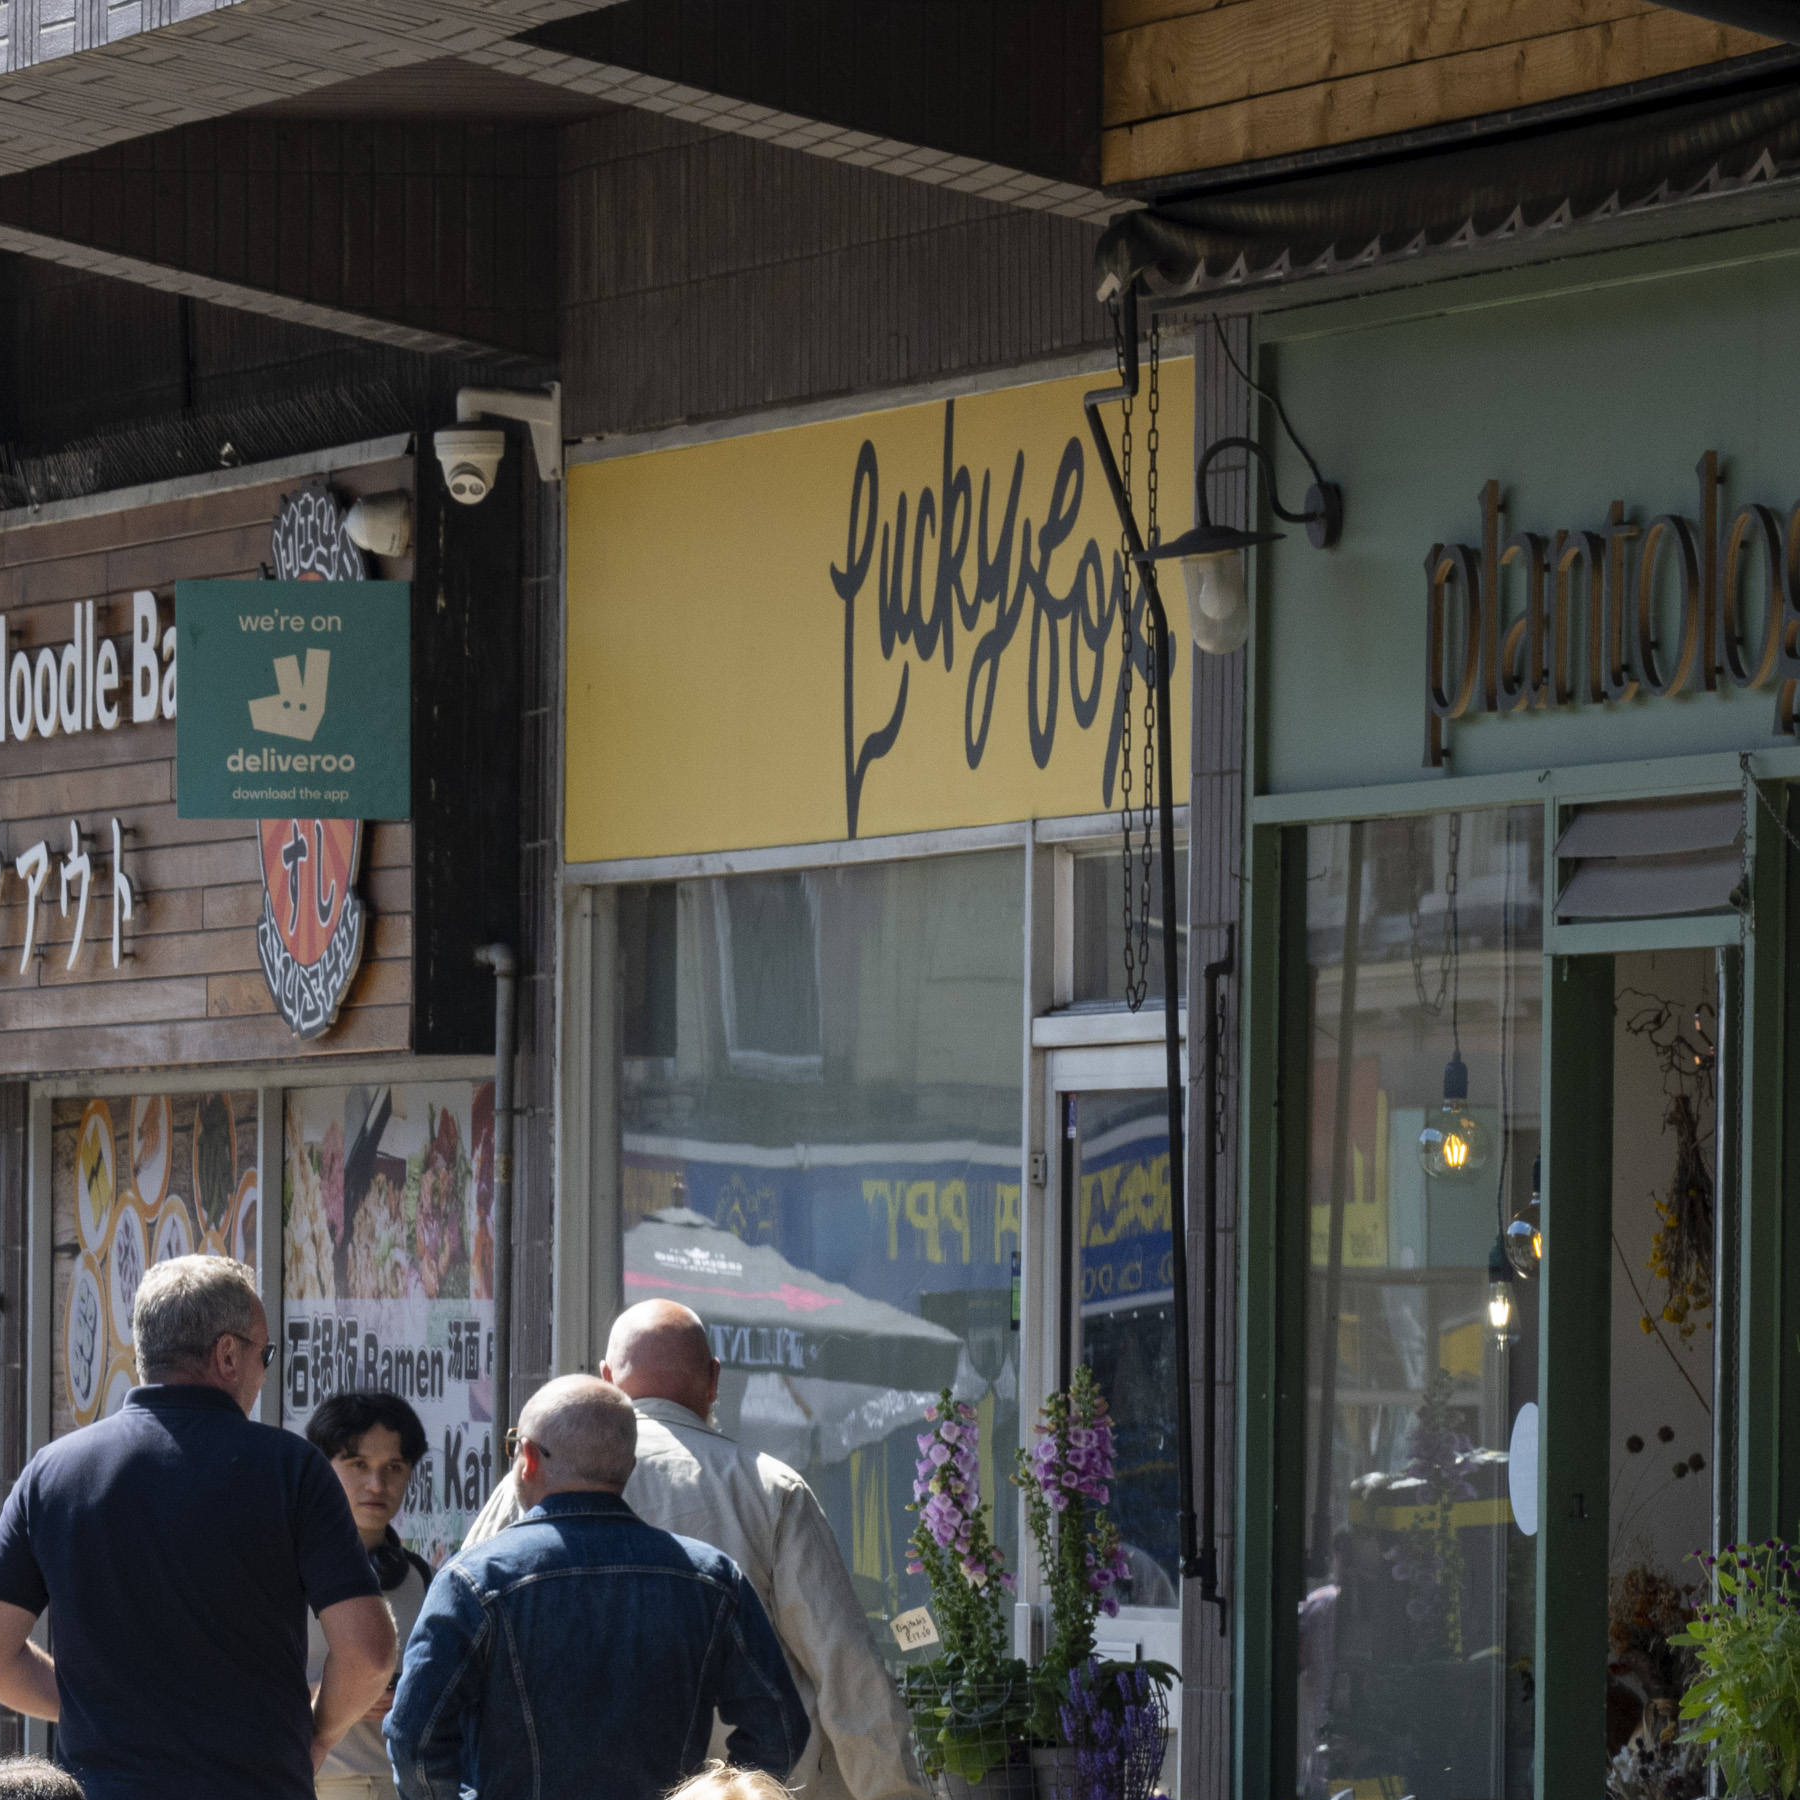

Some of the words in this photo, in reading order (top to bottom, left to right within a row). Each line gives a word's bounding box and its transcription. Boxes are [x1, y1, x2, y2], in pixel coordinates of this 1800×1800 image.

[238, 608, 305, 633] we're
[311, 615, 343, 633] on
[226, 747, 355, 774] deliveroo
[232, 787, 296, 801] download
[299, 788, 321, 801] the
[323, 790, 350, 804] app
[364, 1332, 445, 1400] Ramen
